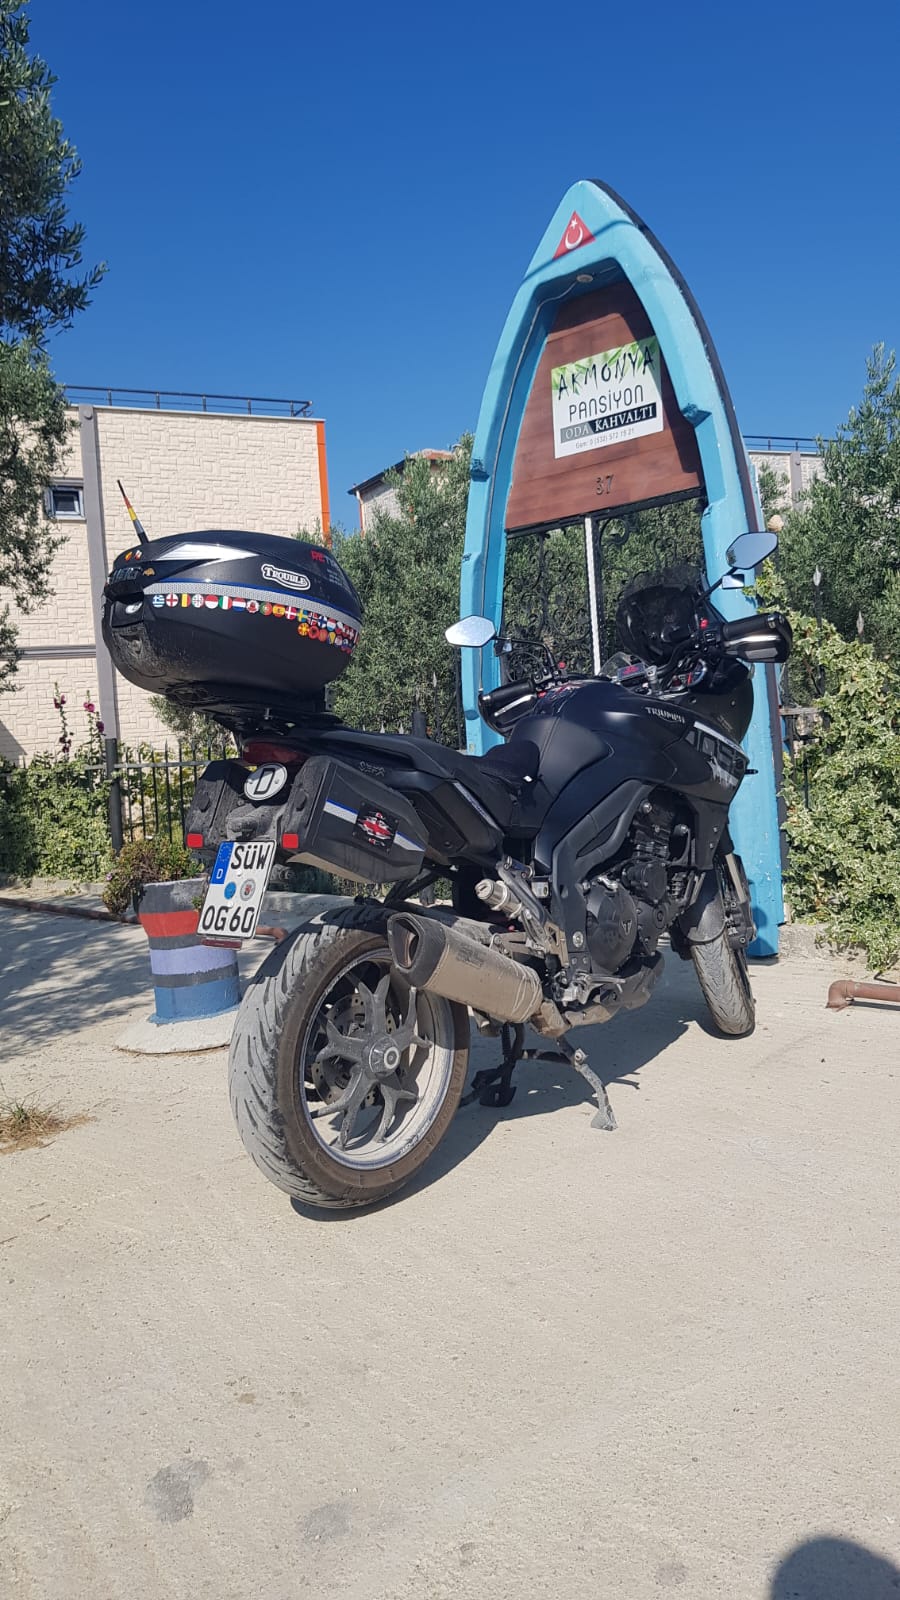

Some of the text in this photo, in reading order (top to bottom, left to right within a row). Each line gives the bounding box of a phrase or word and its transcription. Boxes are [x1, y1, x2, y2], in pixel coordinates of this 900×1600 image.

[565, 405, 653, 439] ODA KAHVALTI
[596, 475, 614, 495] 37
[264, 566, 308, 585] TROUBLE
[645, 706, 685, 723] TRIUMPH
[253, 768, 275, 795] D
[231, 845, 271, 870] SÜW
[216, 868, 224, 880] D
